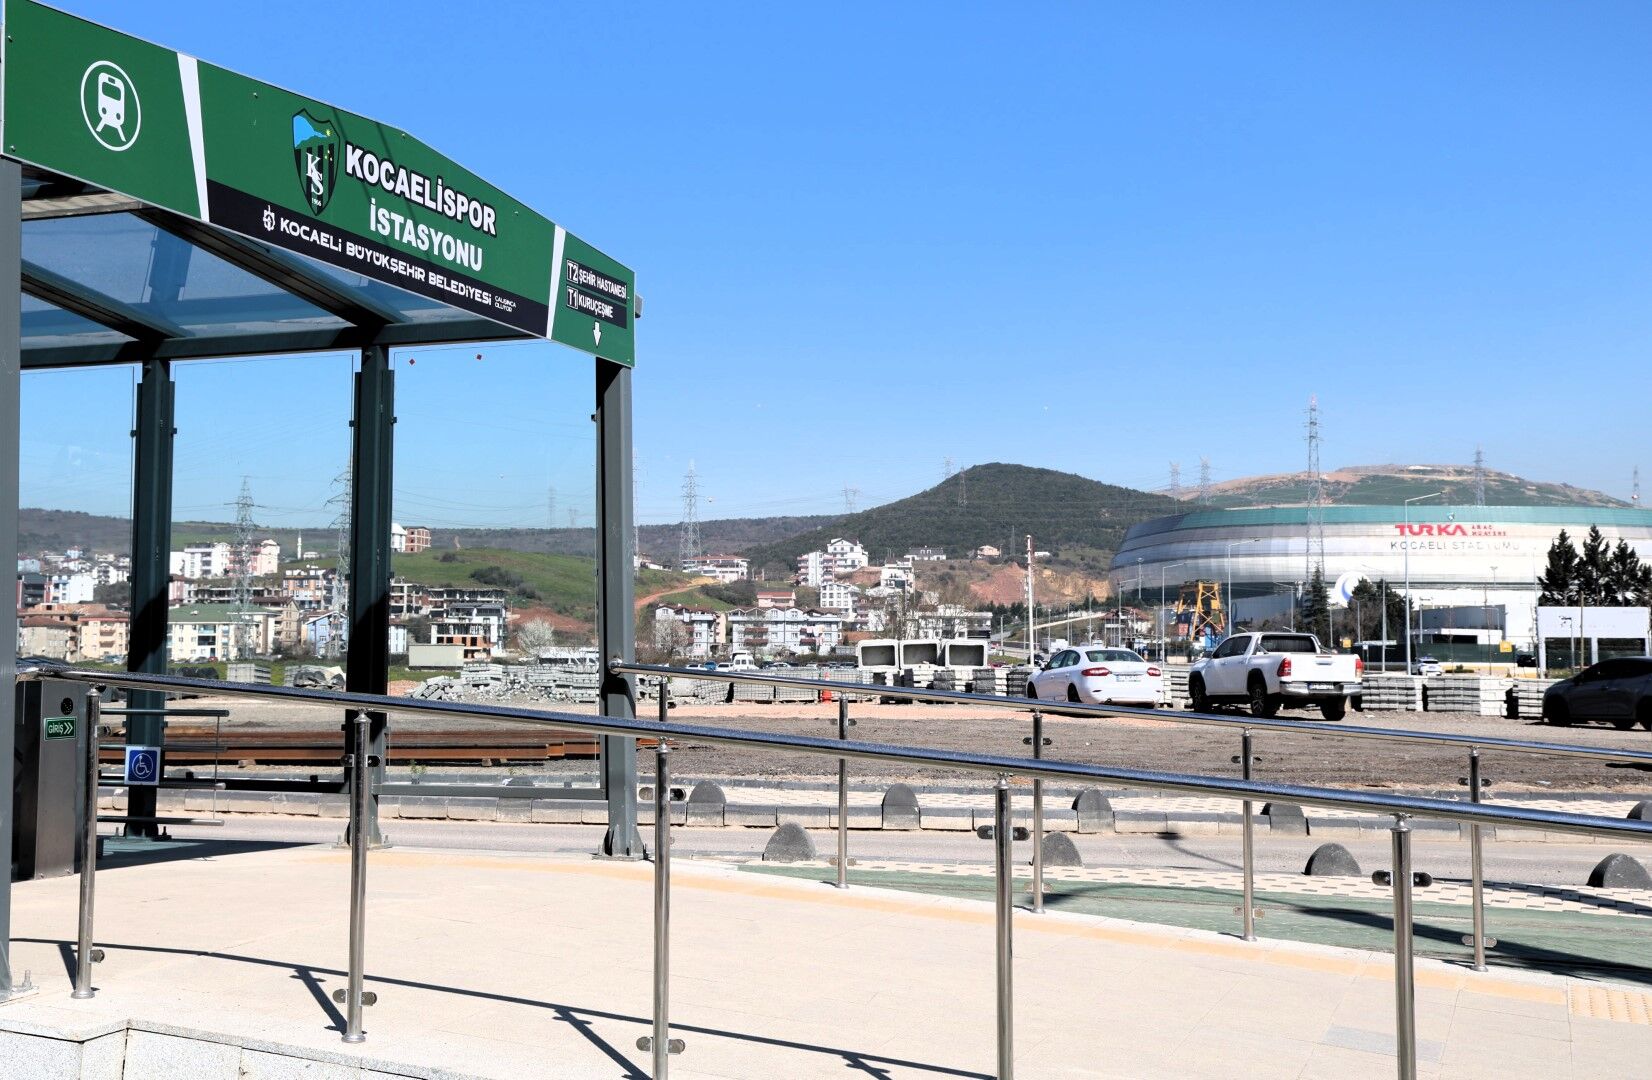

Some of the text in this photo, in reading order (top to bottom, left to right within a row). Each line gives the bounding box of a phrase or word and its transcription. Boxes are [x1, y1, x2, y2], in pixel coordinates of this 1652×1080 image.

[345, 143, 497, 236] KOCAELİSPOR
[280, 217, 492, 306] KOCAELİ BÜYÜKŞEHİR BELEDİYESİ
[370, 197, 483, 272] İSTASYONU
[568, 262, 627, 299] T2 ŞEHİR HASTANESİ
[568, 288, 614, 319] T1 KURUÇEŞME
[1394, 524, 1468, 537] TURKA
